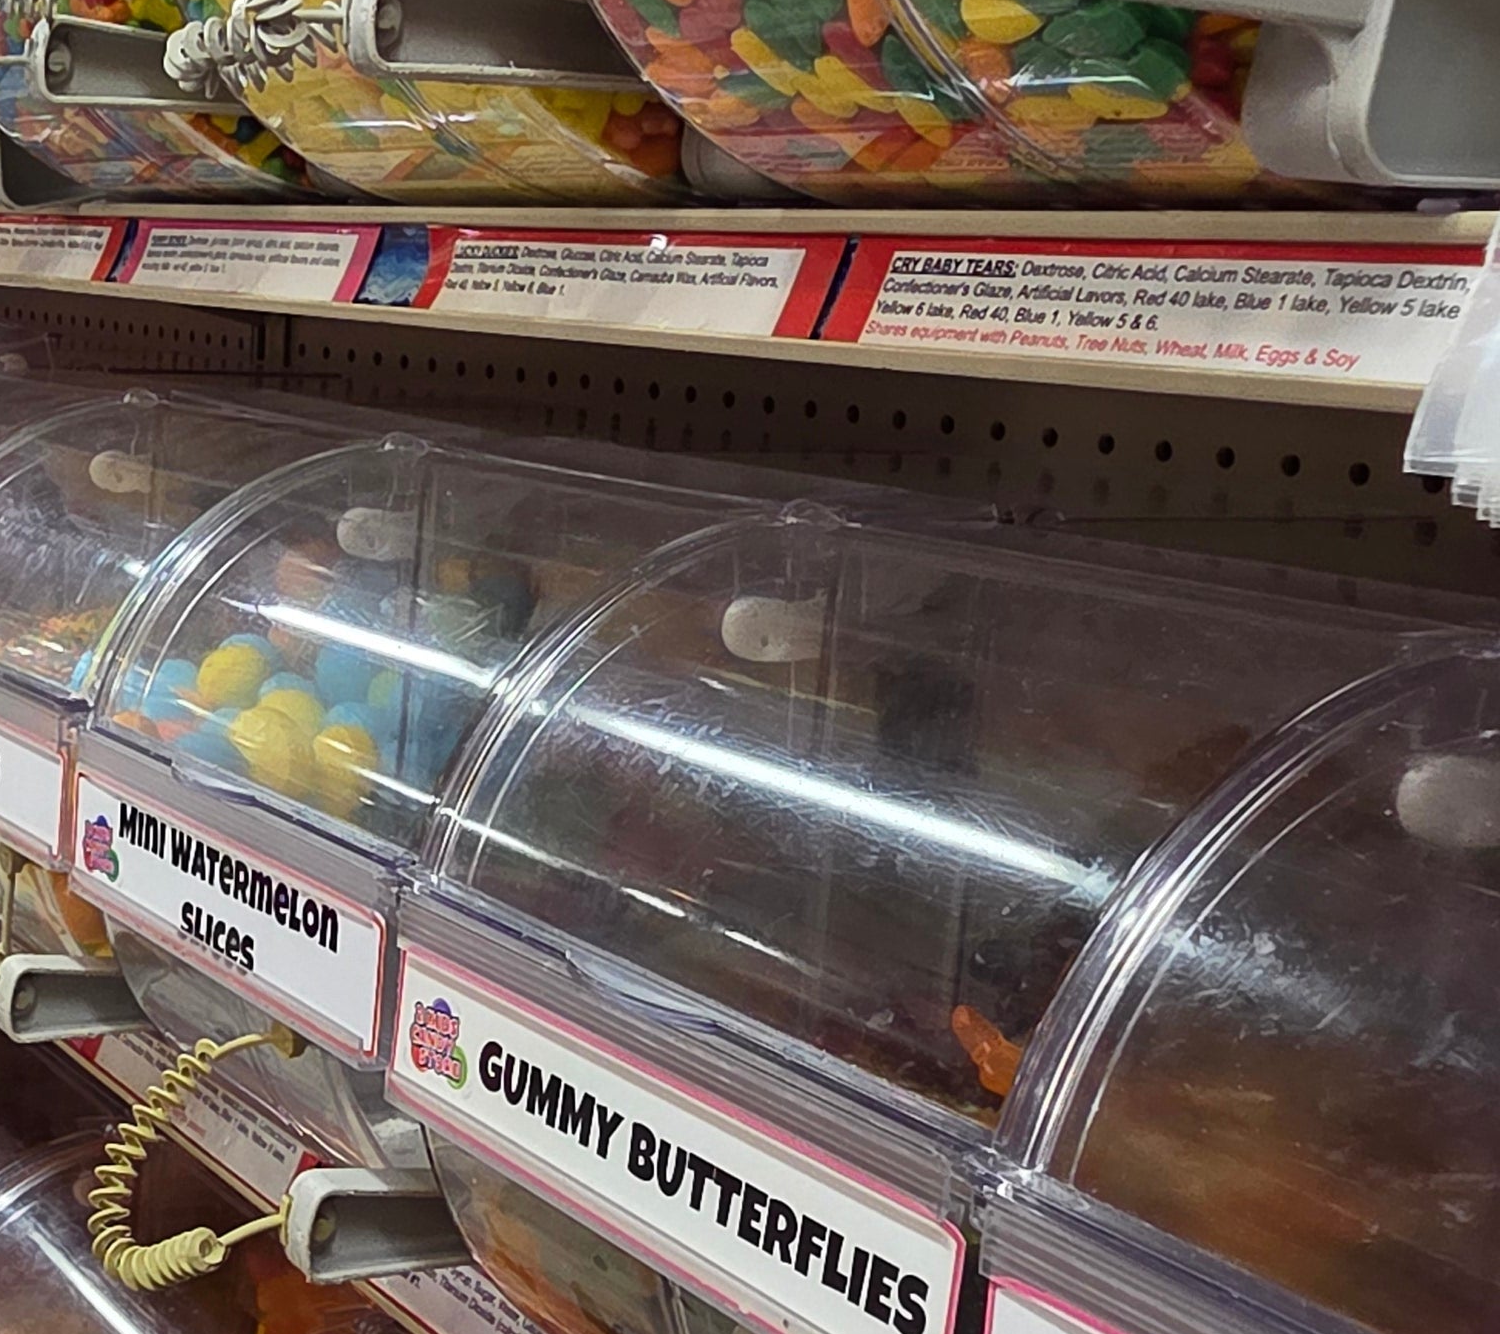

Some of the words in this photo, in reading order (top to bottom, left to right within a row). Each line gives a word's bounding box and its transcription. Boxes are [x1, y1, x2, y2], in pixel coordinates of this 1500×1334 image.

[889, 256, 923, 274] CRY
[919, 257, 963, 276] BABY
[960, 258, 1021, 278] TEARS:
[1020, 260, 1089, 280] Dextrose,
[1090, 262, 1132, 281] Citric
[1129, 264, 1172, 284] Acid,
[1173, 265, 1239, 284] Calcium
[1239, 267, 1318, 288] Stearate,
[1322, 268, 1394, 291] Tapioca
[1395, 271, 1473, 294] Dextrin,
[872, 299, 915, 316] Yellow
[958, 304, 989, 320] Red
[987, 306, 1012, 323] 40,
[1013, 307, 1049, 323] Blue
[1065, 310, 1115, 328] Yellow
[881, 278, 972, 296] Confectioner's
[1016, 284, 1074, 302] Artificial
[1132, 289, 1167, 306] Red
[1166, 291, 1191, 307] 40
[1190, 292, 1231, 311] lake,
[1233, 292, 1273, 311] Blue
[1288, 295, 1333, 315] lake,
[1336, 296, 1397, 317] Yellow
[1418, 299, 1461, 321] lake
[1074, 333, 1110, 351] Tree
[1253, 344, 1302, 368] Eggs
[1321, 348, 1362, 372] Soy
[119, 803, 165, 858] MINI
[479, 1042, 624, 1158] GUMMY
